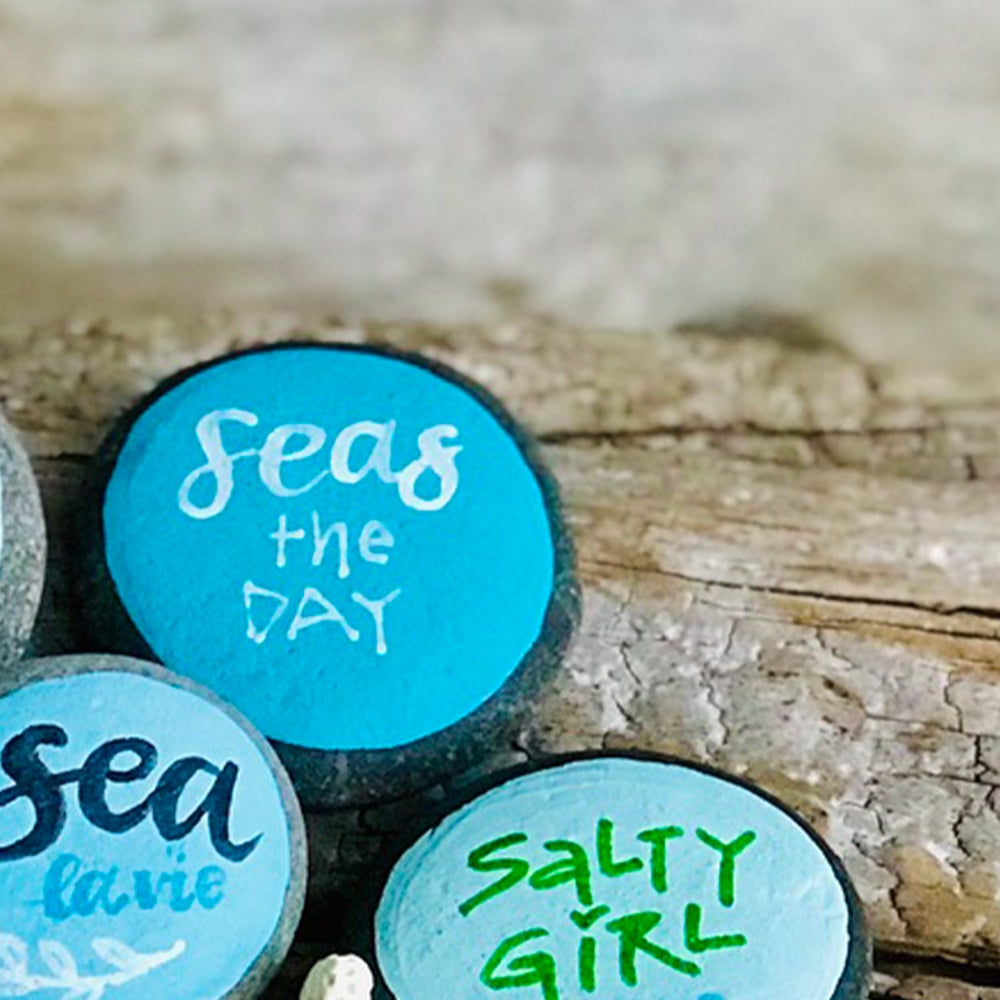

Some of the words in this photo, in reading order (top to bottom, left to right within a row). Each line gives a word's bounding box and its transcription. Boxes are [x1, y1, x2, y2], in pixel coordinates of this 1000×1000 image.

[269, 511, 395, 579] the
[243, 579, 401, 656] DAY
[38, 852, 131, 920] la
